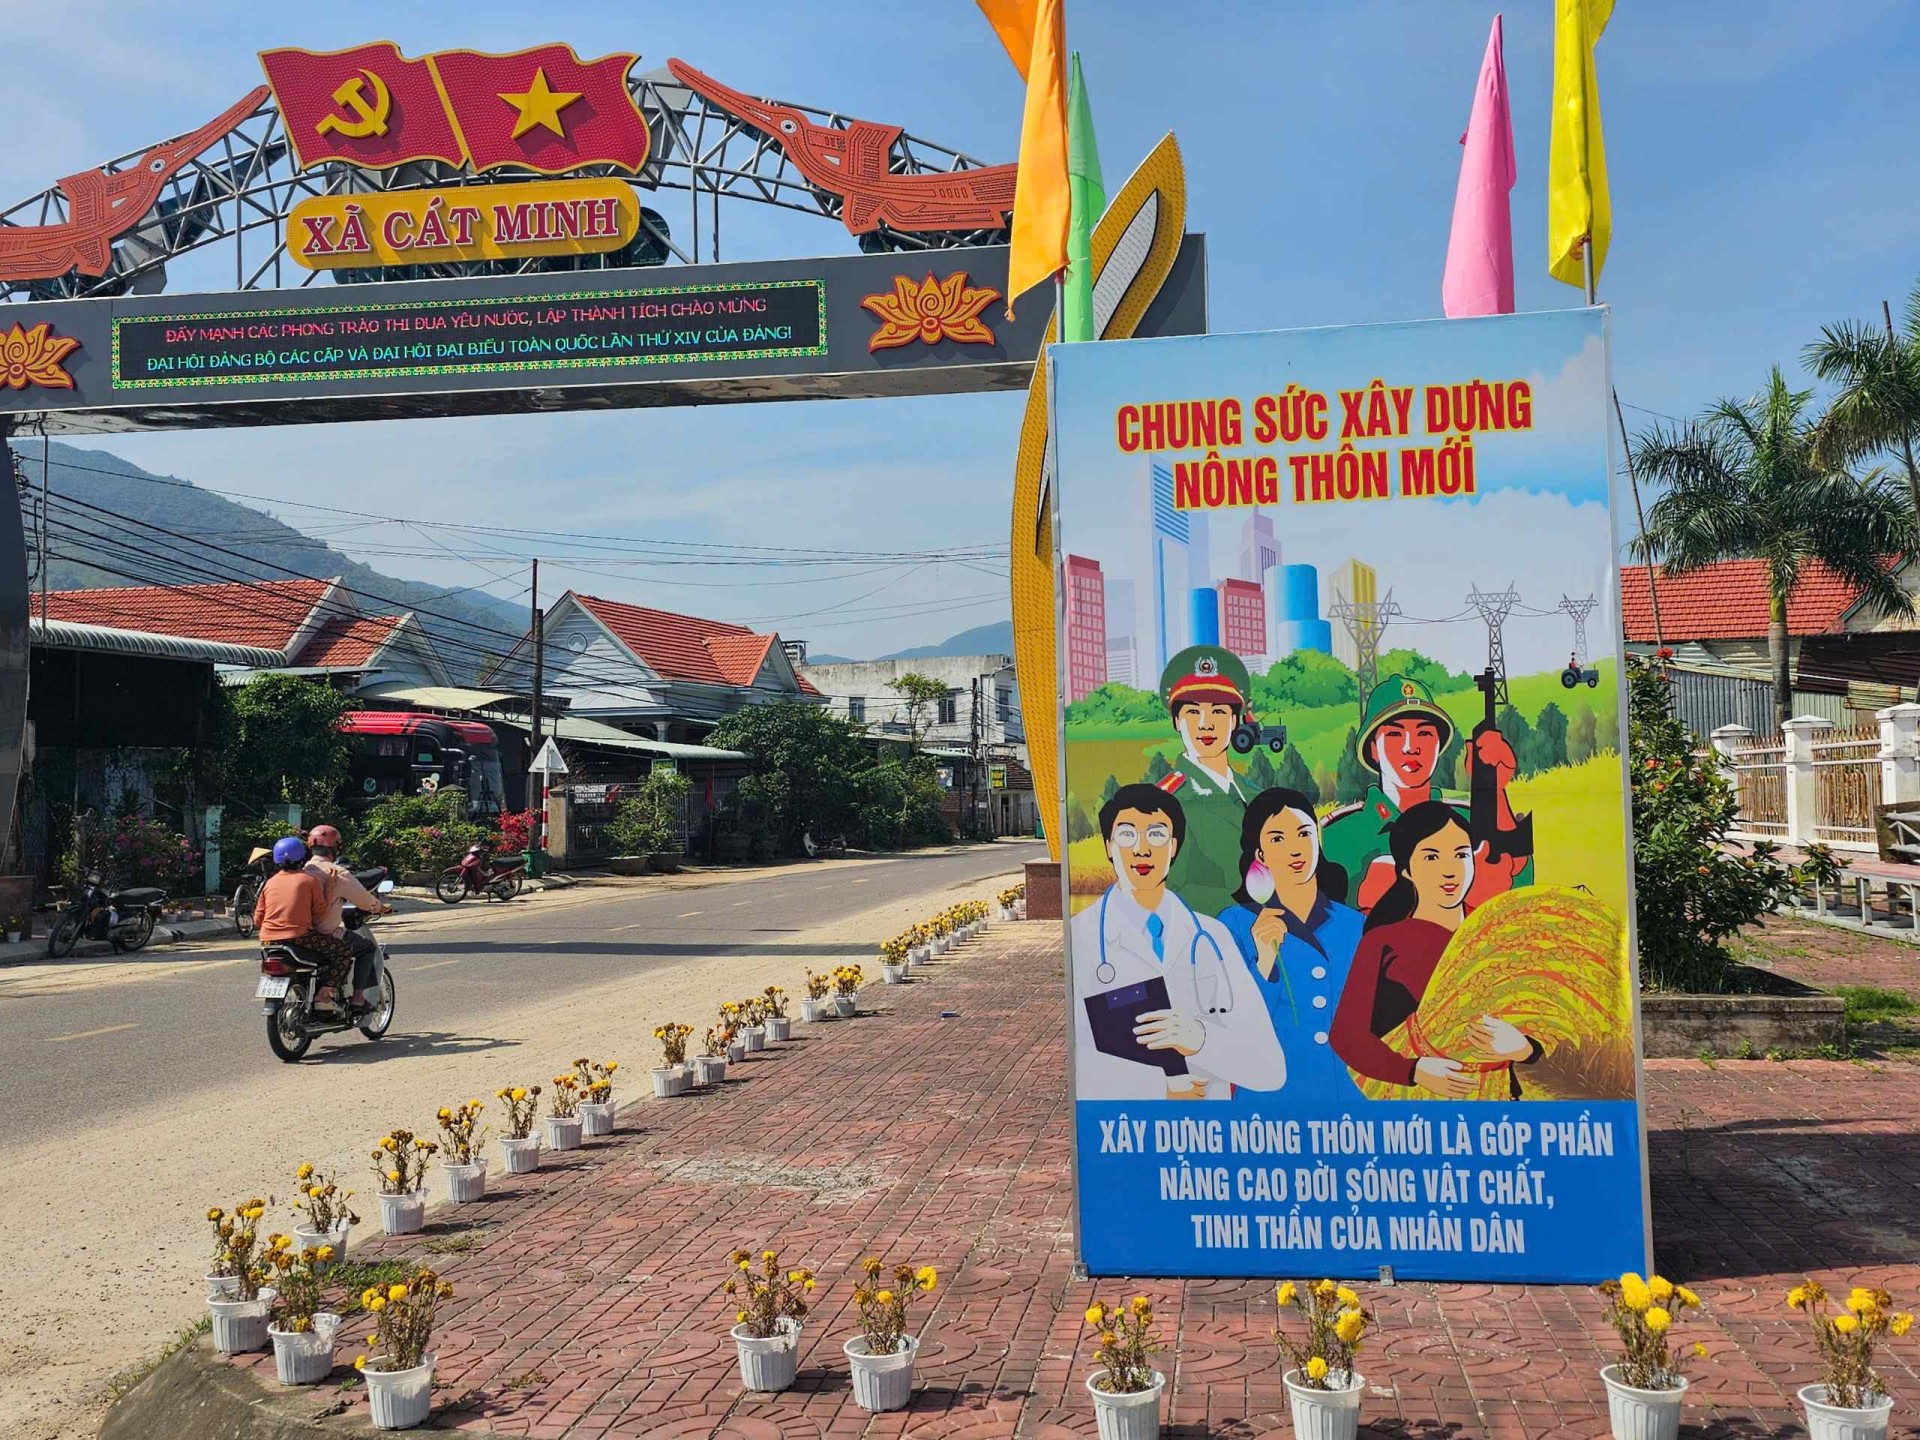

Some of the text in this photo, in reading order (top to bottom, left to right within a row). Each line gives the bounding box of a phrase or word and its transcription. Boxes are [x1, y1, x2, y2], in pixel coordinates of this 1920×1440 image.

[302, 195, 619, 255] XÃ CÁT MINH
[200, 327, 244, 343] MẠNH
[248, 323, 278, 338] CÁC
[281, 322, 334, 337] PHONG
[339, 318, 380, 334] TRÀO
[384, 318, 410, 332] THI
[414, 316, 447, 330] ĐUA
[451, 312, 480, 328] YÊU
[537, 307, 567, 325] LẬP
[571, 305, 625, 322] THÀNH
[629, 302, 667, 319] TÍCH
[671, 299, 714, 317] CHÀO
[718, 297, 767, 314] MỪNG
[147, 356, 174, 373] ĐẠI
[177, 354, 205, 371] HỘI
[210, 350, 251, 368] ĐẢNG
[255, 350, 276, 367] BỘ
[279, 348, 310, 364] CÁC
[348, 345, 368, 361] VÀ
[373, 346, 400, 362] ĐẠI
[404, 343, 432, 361] HỘI
[437, 343, 463, 359] ĐẠI
[468, 338, 505, 355] BIỂU
[509, 336, 551, 354] TOÀN
[674, 331, 701, 345] XIV
[705, 326, 738, 344] CỦA
[743, 324, 792, 342] ĐẢNG!
[1116, 377, 1533, 453] CHUNG SỨC XÂY DỰNG
[1174, 435, 1477, 511] NÔNG THÔN MỚI
[1100, 1110, 1614, 1161] XÂY DỰNG NÔNG THÔN MỚI LÀ GÓP PHẦN
[1159, 1156, 1554, 1211] NÂNG CAO ĐỜI SỐNG VẬT CHẤT,
[1191, 1203, 1525, 1254] TINH THẦN CỦA NHÂN DÂN
